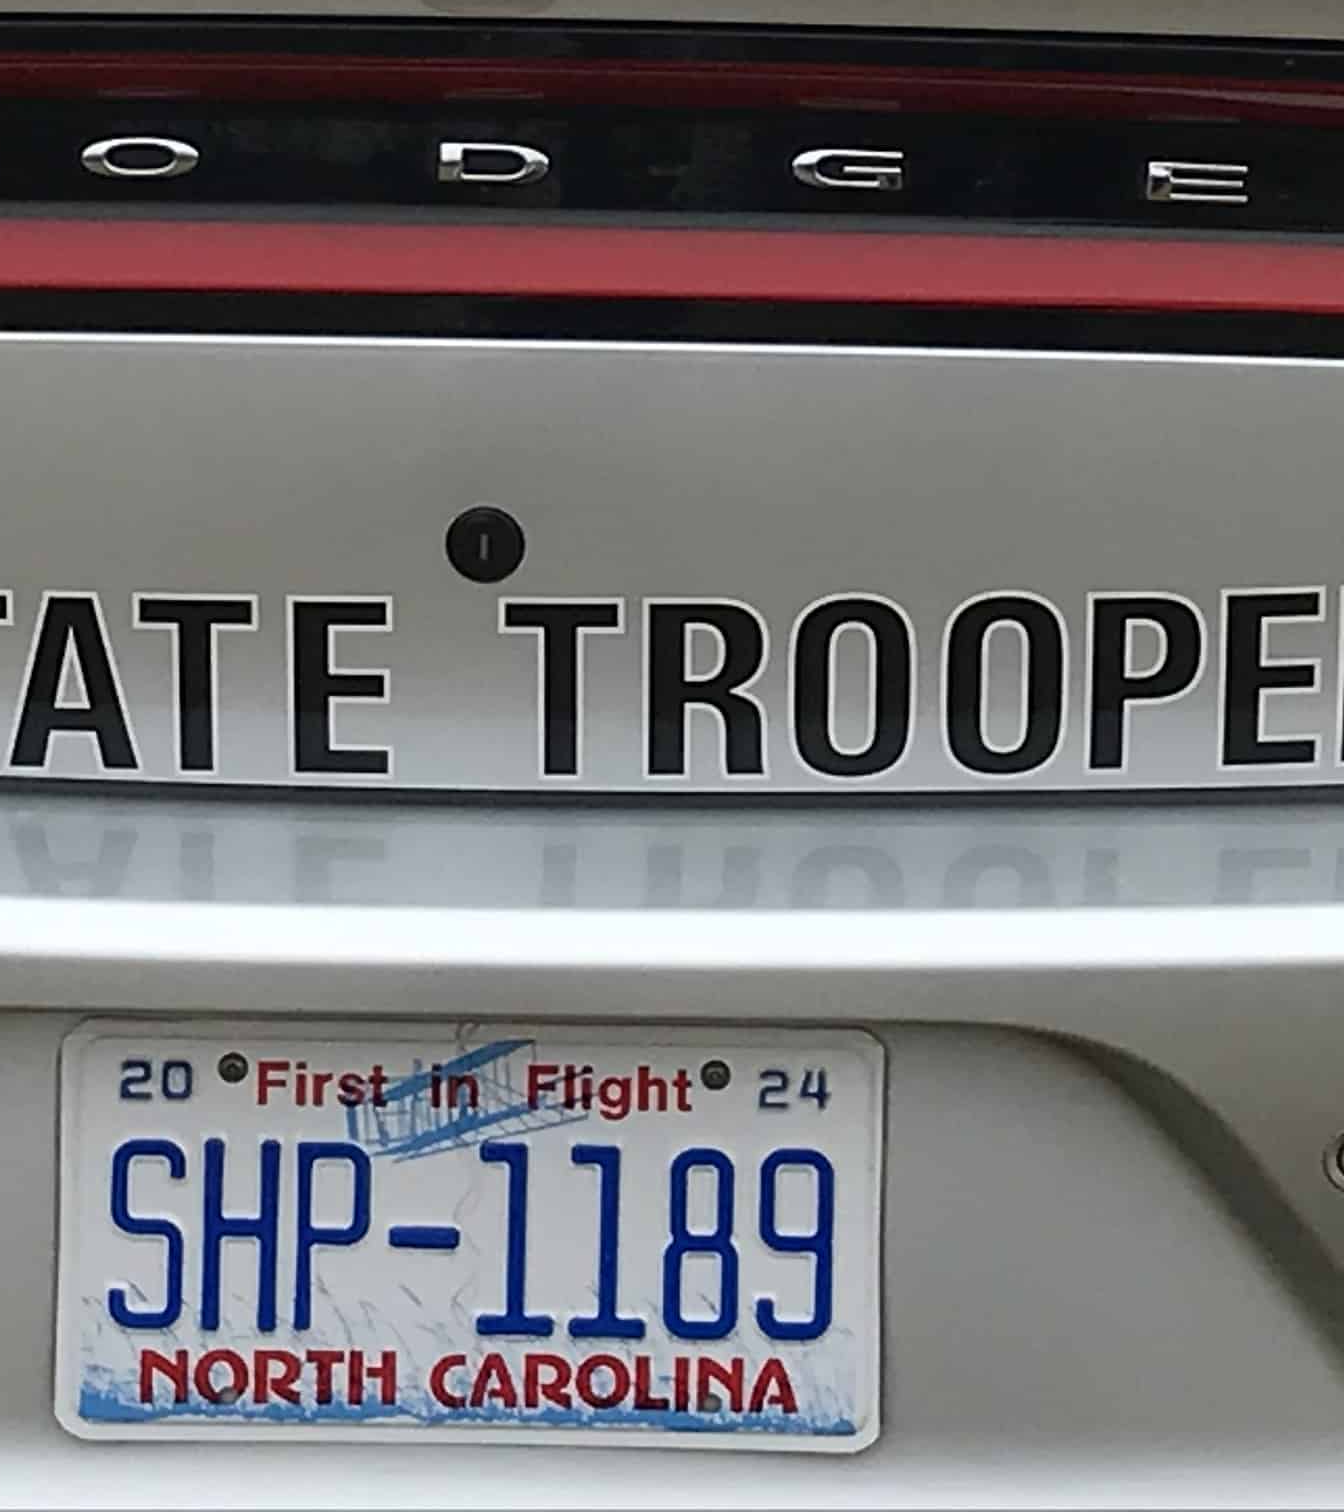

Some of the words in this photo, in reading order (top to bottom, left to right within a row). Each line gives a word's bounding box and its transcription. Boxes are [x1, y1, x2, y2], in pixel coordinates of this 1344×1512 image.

[119, 1059, 194, 1101] 20
[256, 1061, 388, 1109] First
[430, 1061, 480, 1109] in
[526, 1064, 694, 1121] Flight
[757, 1067, 831, 1111] 24
[107, 1136, 836, 1341] SHP-1189
[139, 1348, 397, 1408] NORTH
[429, 1352, 798, 1414] CAROLINA
